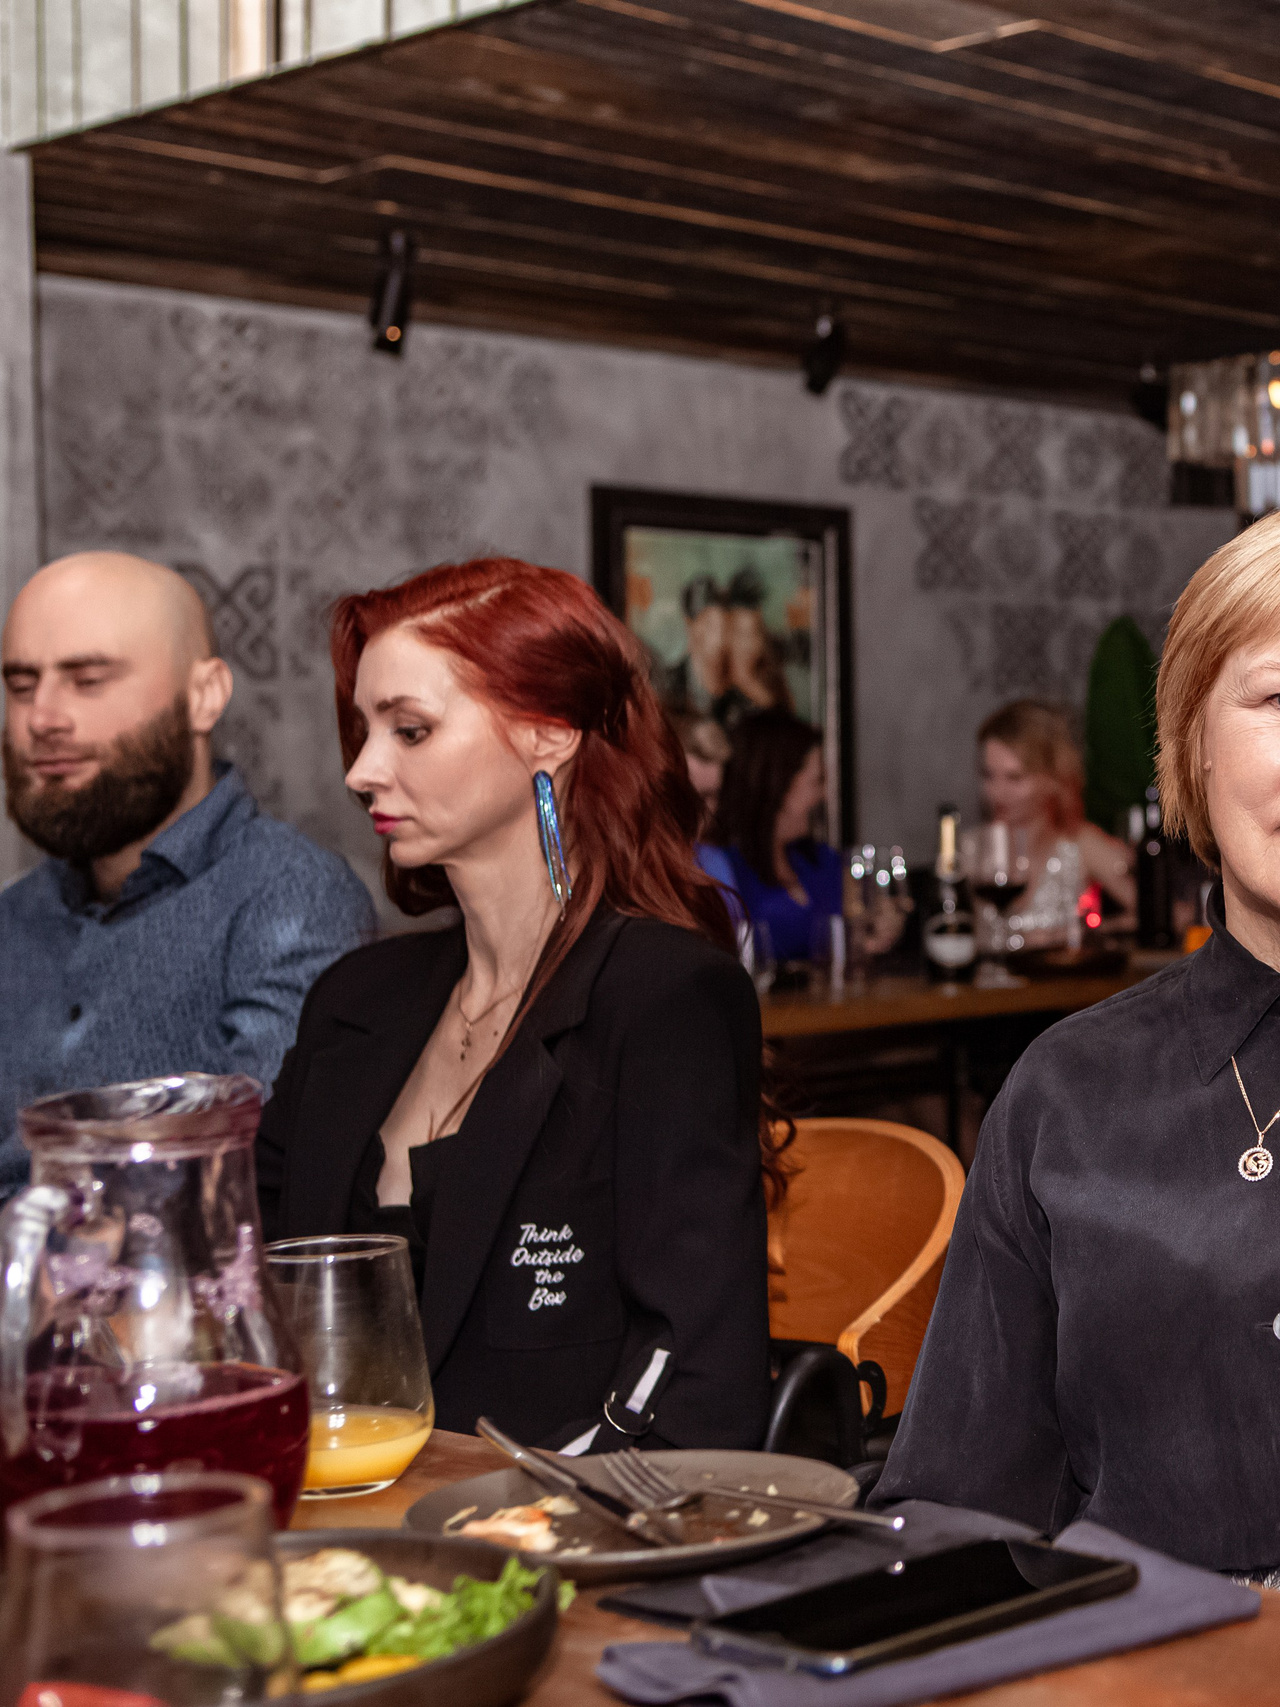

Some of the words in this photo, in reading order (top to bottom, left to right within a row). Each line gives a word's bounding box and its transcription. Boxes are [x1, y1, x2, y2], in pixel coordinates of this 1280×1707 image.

[519, 1223, 573, 1246] Think
[511, 1244, 585, 1266] Outside
[534, 1268, 565, 1284] the
[528, 1287, 567, 1311] Box
